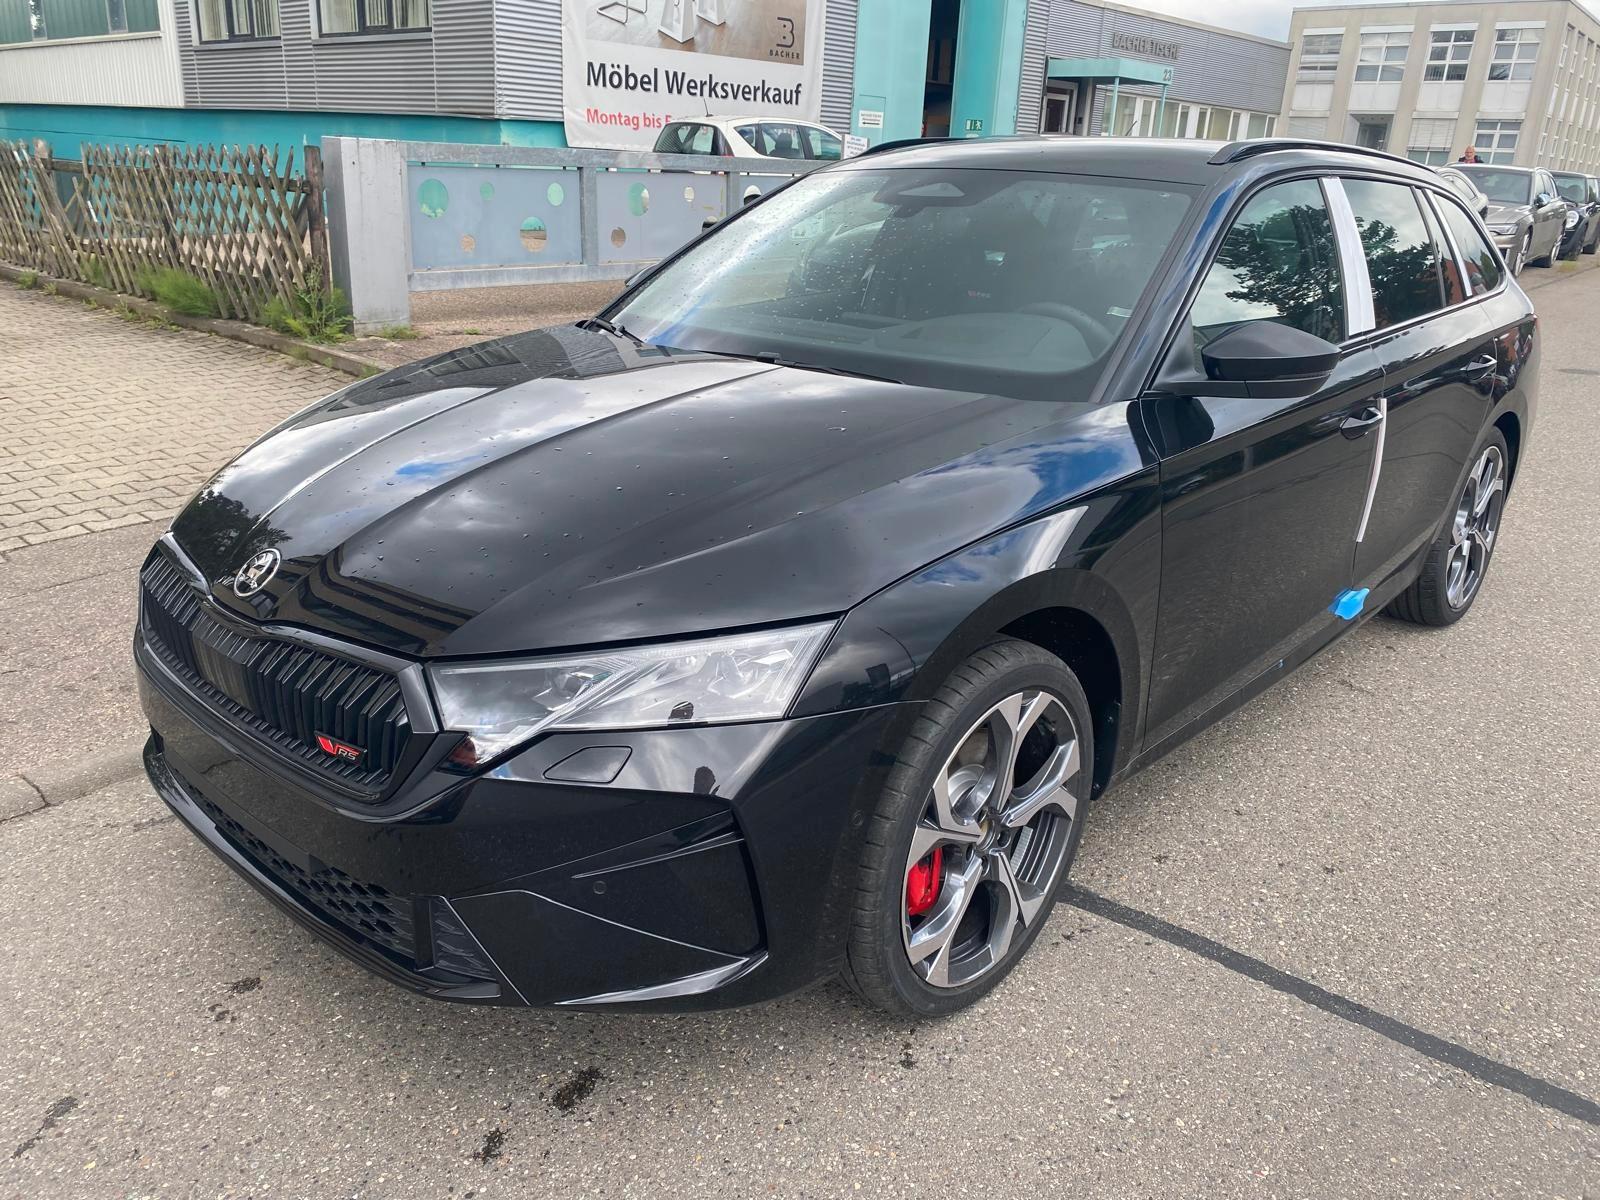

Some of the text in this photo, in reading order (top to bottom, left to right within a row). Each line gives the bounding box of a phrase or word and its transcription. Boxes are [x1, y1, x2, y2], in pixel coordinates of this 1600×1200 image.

[769, 49, 800, 59] BACHER
[586, 61, 802, 106] Möbel Werksverkauf
[1163, 68, 1172, 81] 23
[586, 108, 640, 131] Montag
[643, 112, 662, 128] bis
